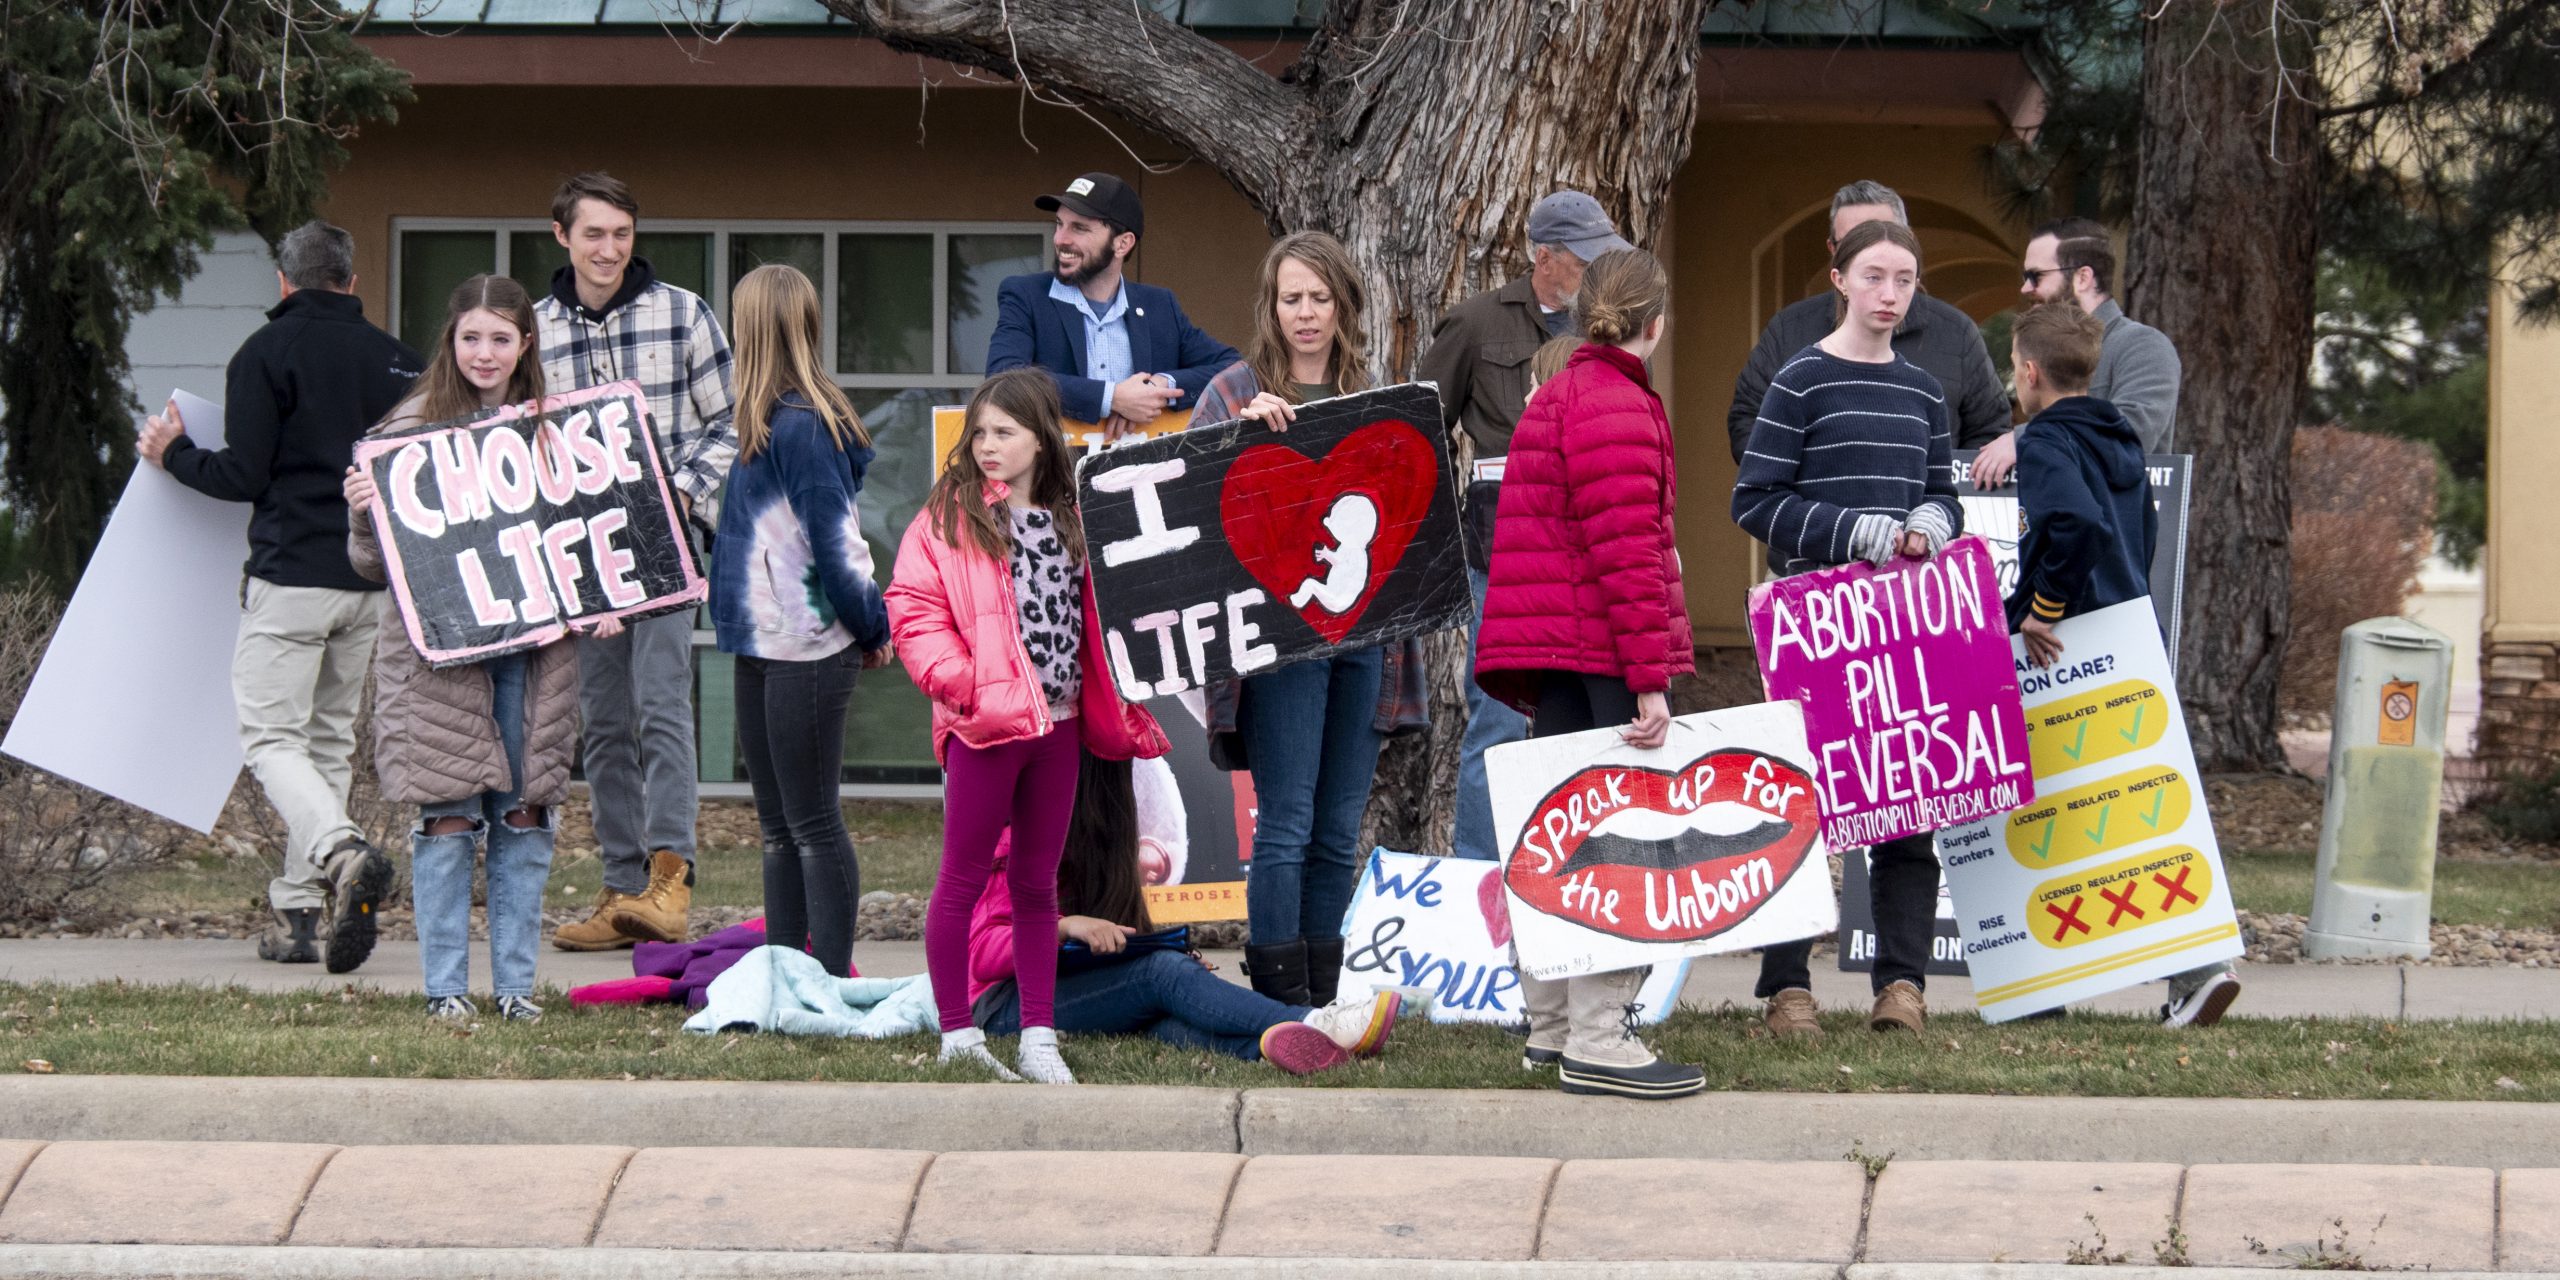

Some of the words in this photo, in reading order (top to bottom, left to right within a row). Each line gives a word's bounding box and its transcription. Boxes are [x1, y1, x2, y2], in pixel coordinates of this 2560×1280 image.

[389, 400, 642, 539] CHOOSE
[1091, 457, 1200, 568] I
[456, 507, 647, 627] LIFE
[1769, 551, 1985, 671] ABORTION
[1106, 587, 1278, 701] LIFE
[2055, 654, 2115, 685] CARE?
[1846, 646, 1950, 727] PILL
[2044, 705, 2098, 727] REGULATED
[2105, 688, 2156, 710] INSPECTED
[1742, 757, 1805, 816] for
[1826, 779, 2021, 850] ABORTIONPILLREVERSAL.COM
[2014, 807, 2058, 827] LICENSED
[2067, 789, 2121, 812] REGULATED
[2128, 772, 2179, 794] INSPECTED
[1943, 826, 1992, 849] Surgical
[1948, 847, 1996, 867] Centers
[1372, 850, 1442, 907] We
[1560, 870, 1620, 925] the
[1644, 857, 1774, 931] Unborn
[2039, 883, 2083, 903] LICENSED
[2087, 867, 2141, 889] REGULATED
[2143, 852, 2194, 873] INSPECTED
[1967, 931, 2027, 954] Collective
[1978, 914, 2006, 931] RISE
